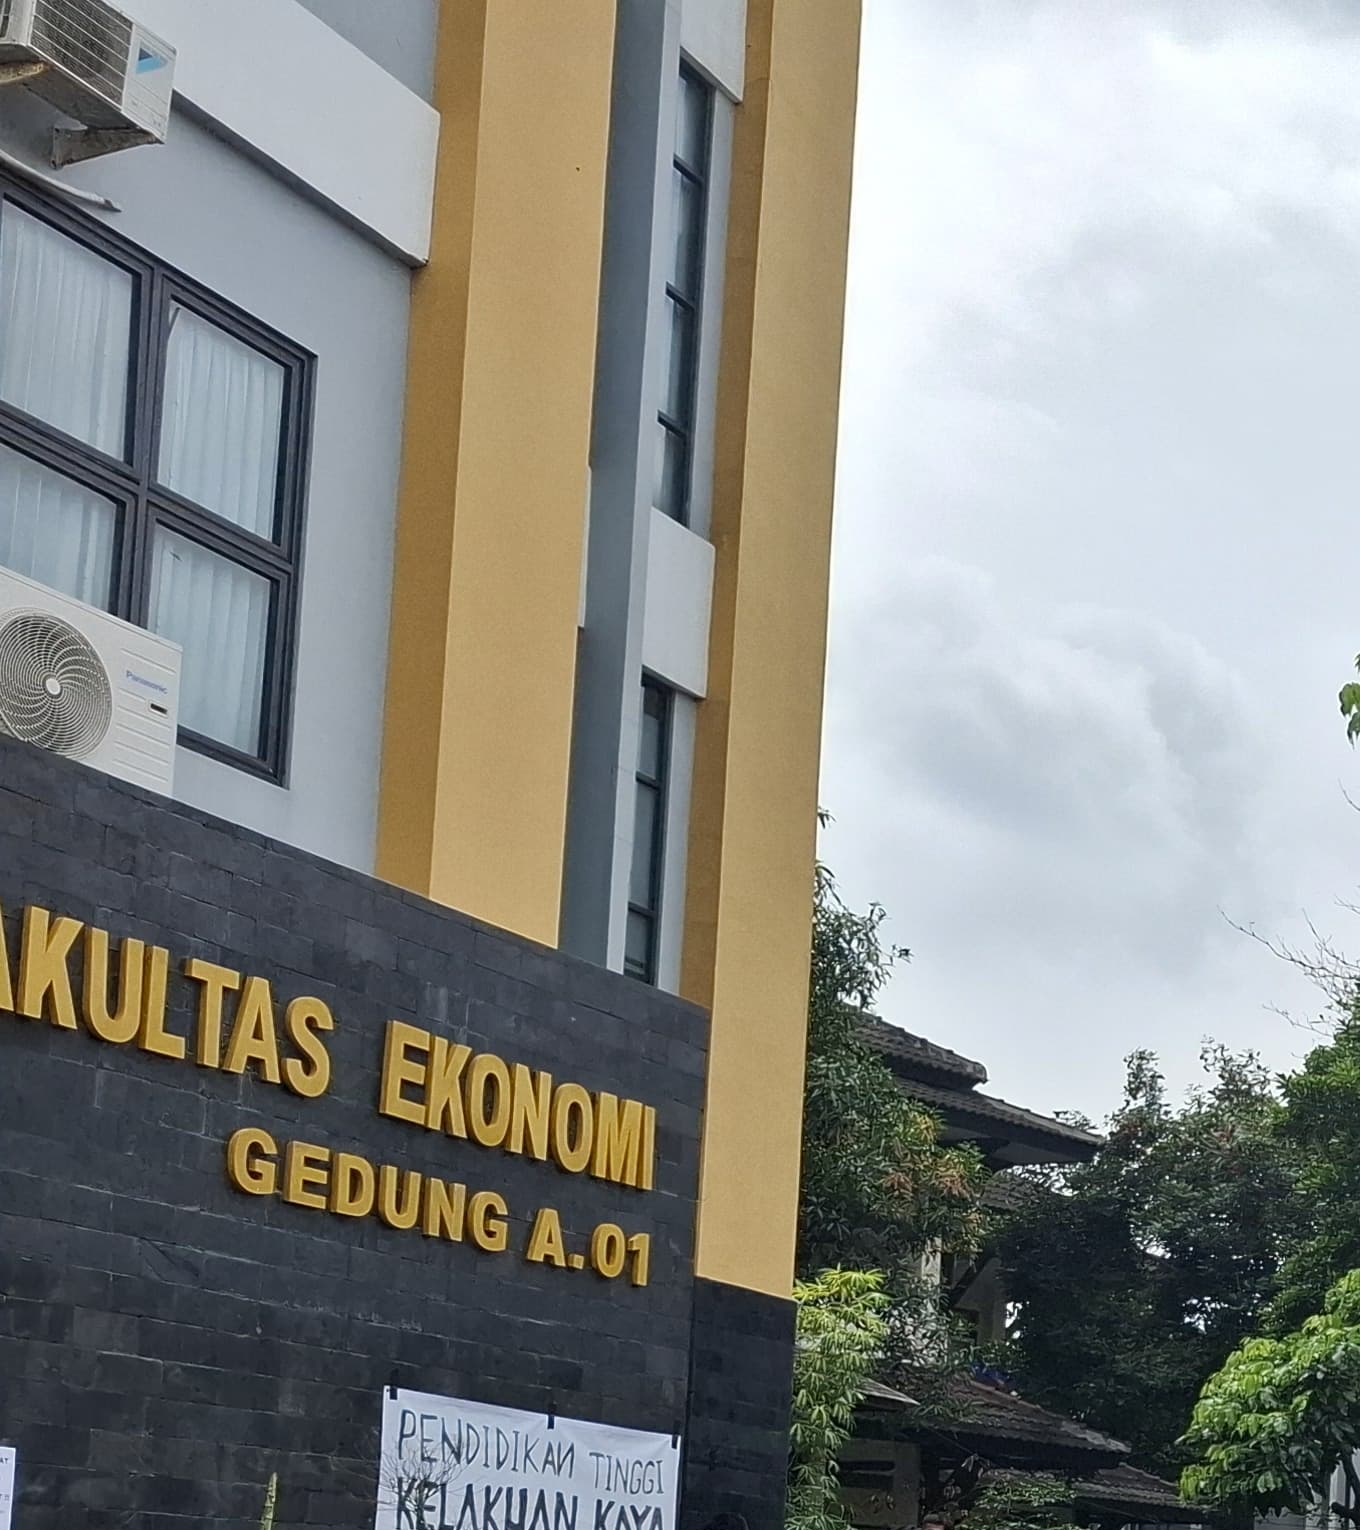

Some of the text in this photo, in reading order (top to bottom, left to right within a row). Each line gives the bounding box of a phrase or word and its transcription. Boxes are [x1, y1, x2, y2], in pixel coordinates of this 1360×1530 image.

[0, 899, 657, 1191] KULTAS EKONOMI
[227, 1127, 651, 1287] GEDUNG A.01
[399, 1409, 664, 1495] PENDIDIKAN TINGGI
